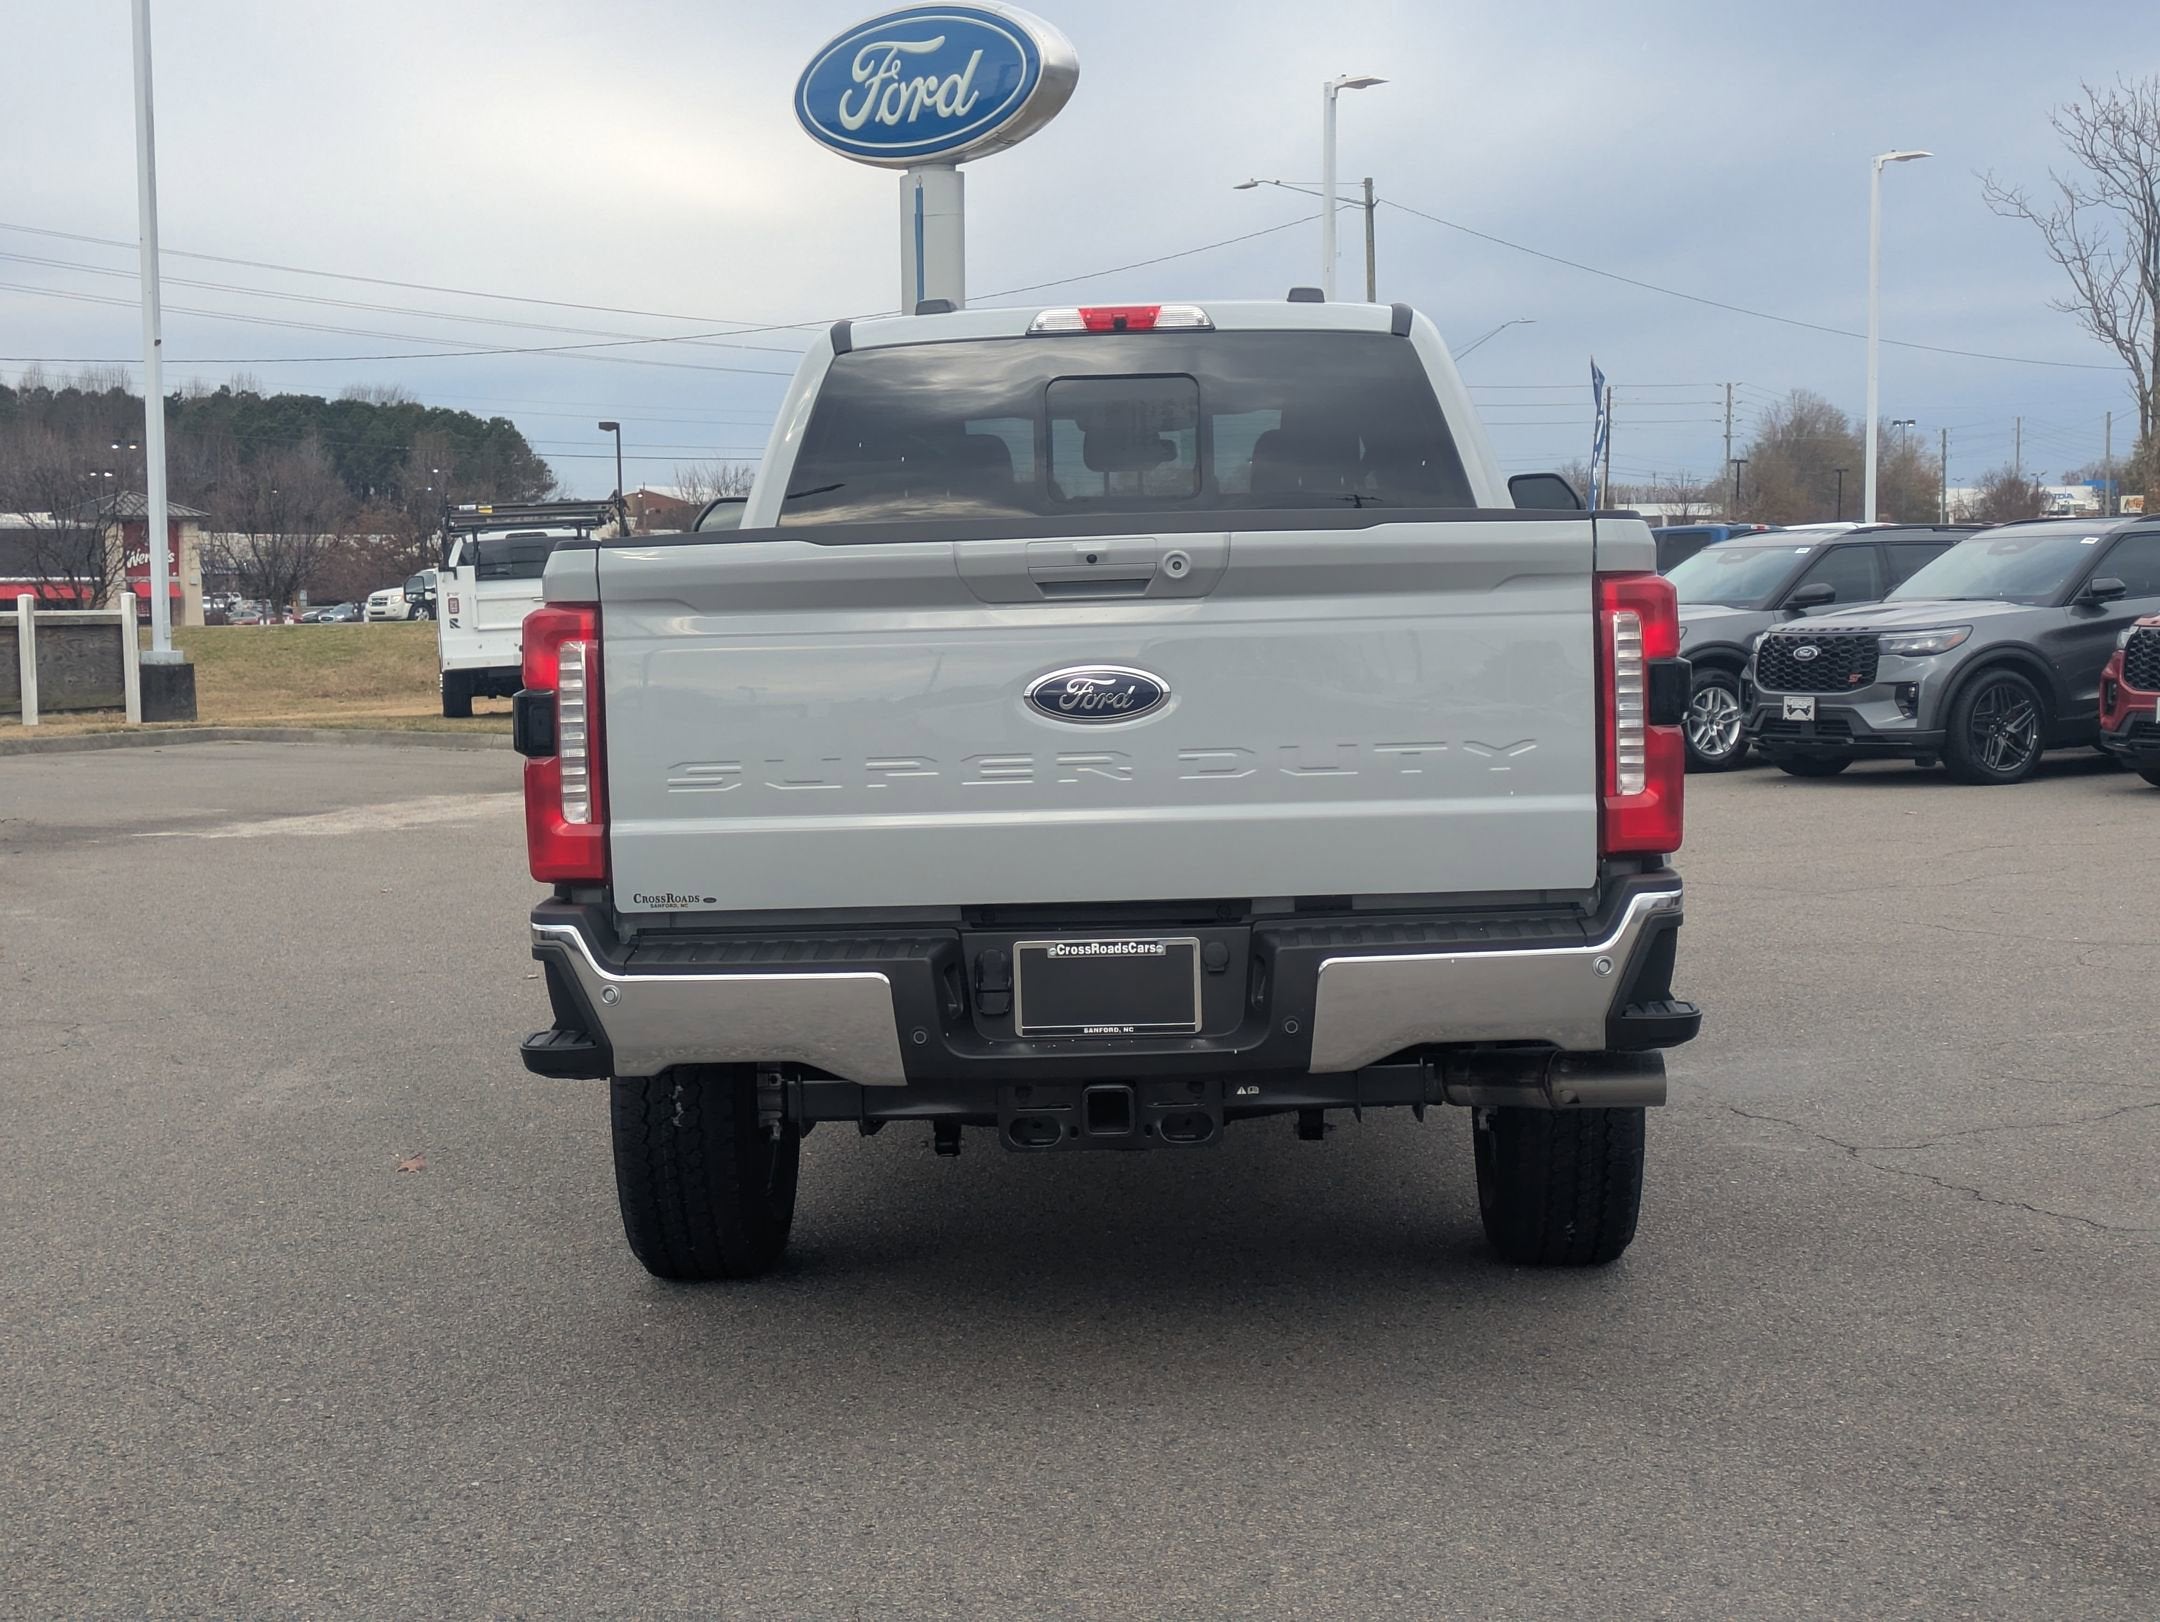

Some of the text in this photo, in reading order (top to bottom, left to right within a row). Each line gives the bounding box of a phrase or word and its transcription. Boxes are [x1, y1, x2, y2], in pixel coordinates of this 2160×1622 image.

[839, 35, 983, 131] Ford
[1058, 677, 1136, 710] Ford
[667, 738, 1538, 793] SUPER DUTY
[1056, 942, 1156, 955] CrossRoadsCars
[1083, 1026, 1122, 1034] SANFORD,
